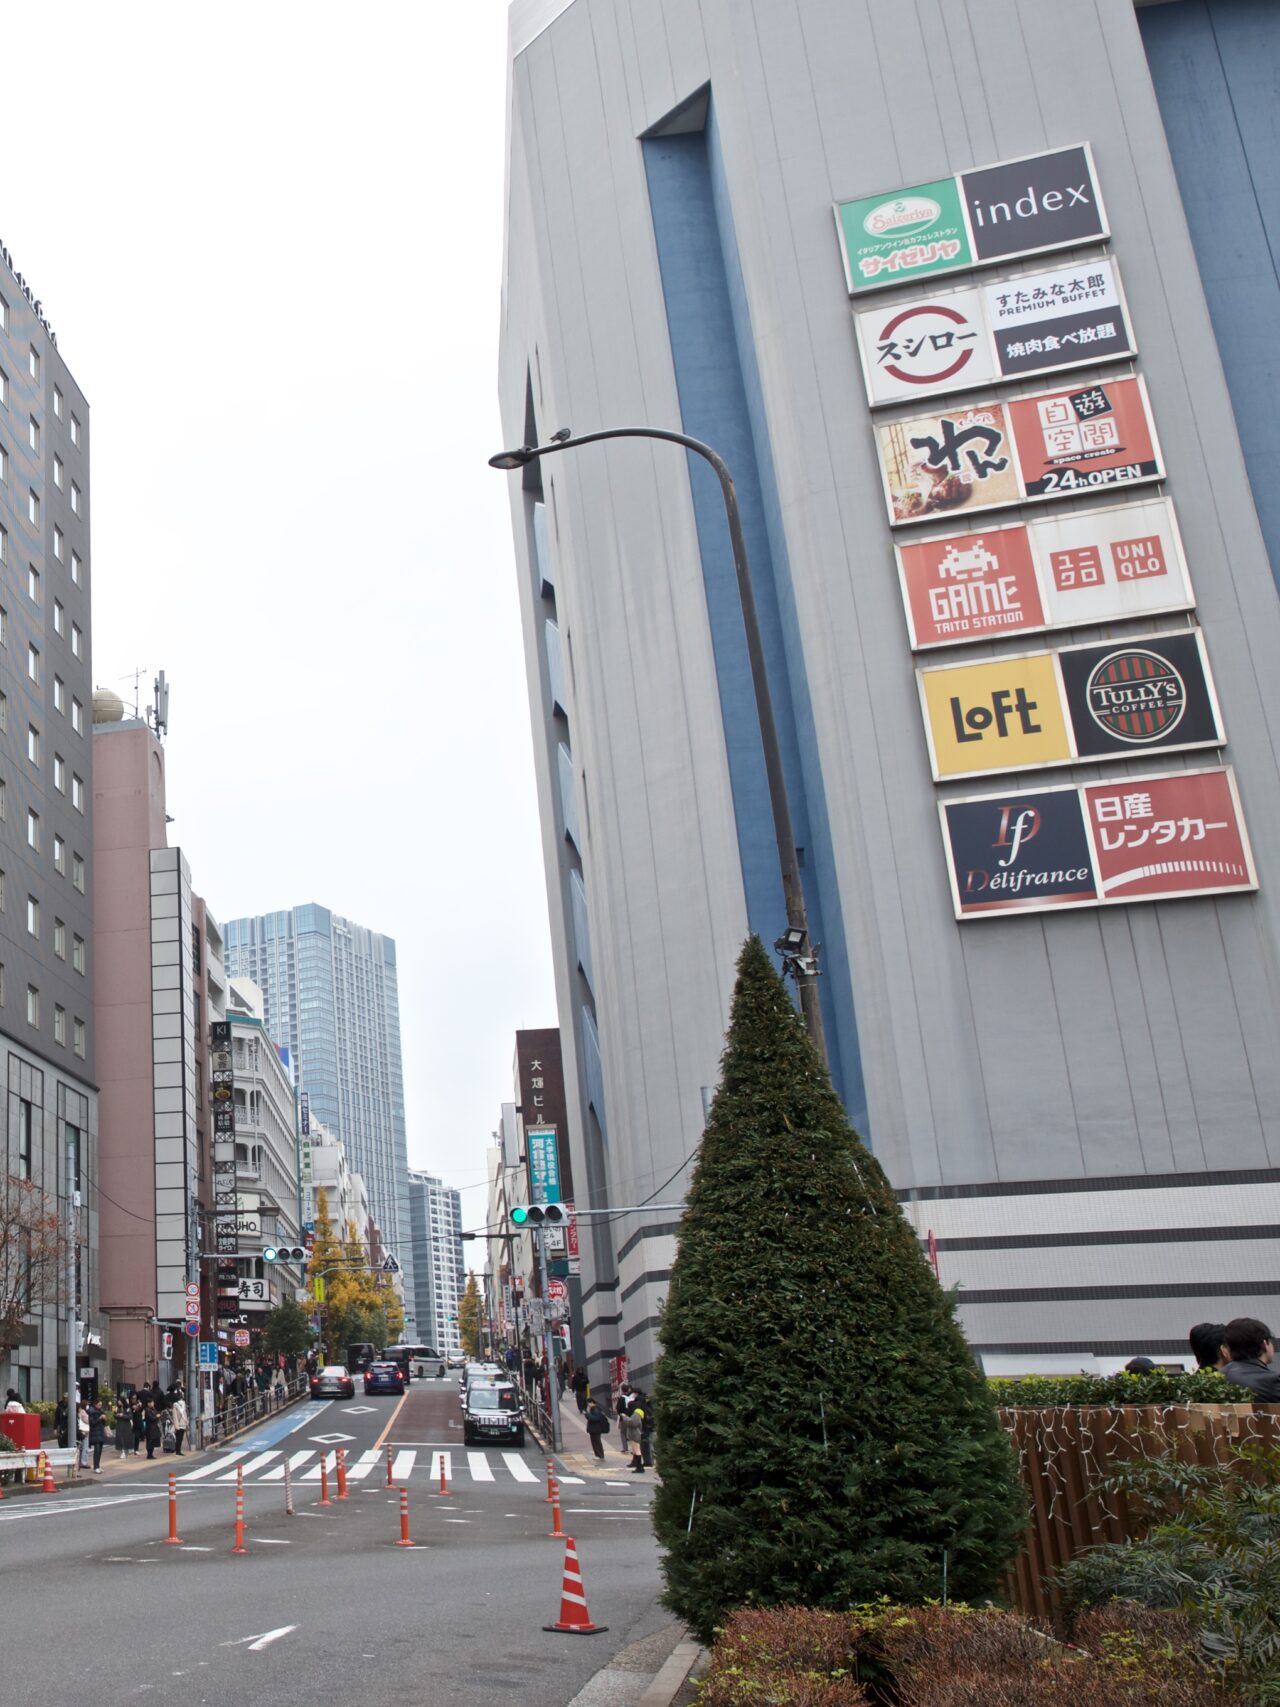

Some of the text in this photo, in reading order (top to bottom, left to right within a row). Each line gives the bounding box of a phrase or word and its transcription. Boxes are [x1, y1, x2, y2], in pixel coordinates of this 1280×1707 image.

[973, 183, 1090, 228] index
[859, 239, 961, 278] サイゼリヤ
[996, 274, 1106, 308] すたみな太郎
[999, 287, 1107, 317] PREMIUM BUFFET
[876, 329, 978, 365] スシロー
[1006, 321, 1117, 360] 焼肉食べ放題
[909, 419, 1009, 479] わん
[1053, 448, 1116, 465] space create
[1116, 547, 1155, 561] UNI
[1121, 557, 1161, 578] QLO
[929, 575, 1021, 622] GAME
[934, 610, 1025, 635] TAITO STATION
[1111, 700, 1166, 715] COFFEE
[1094, 792, 1155, 823] 日産
[1098, 816, 1229, 851] レンタカー
[964, 867, 1089, 893] Délifrance
[238, 1280, 264, 1299] 寿司
